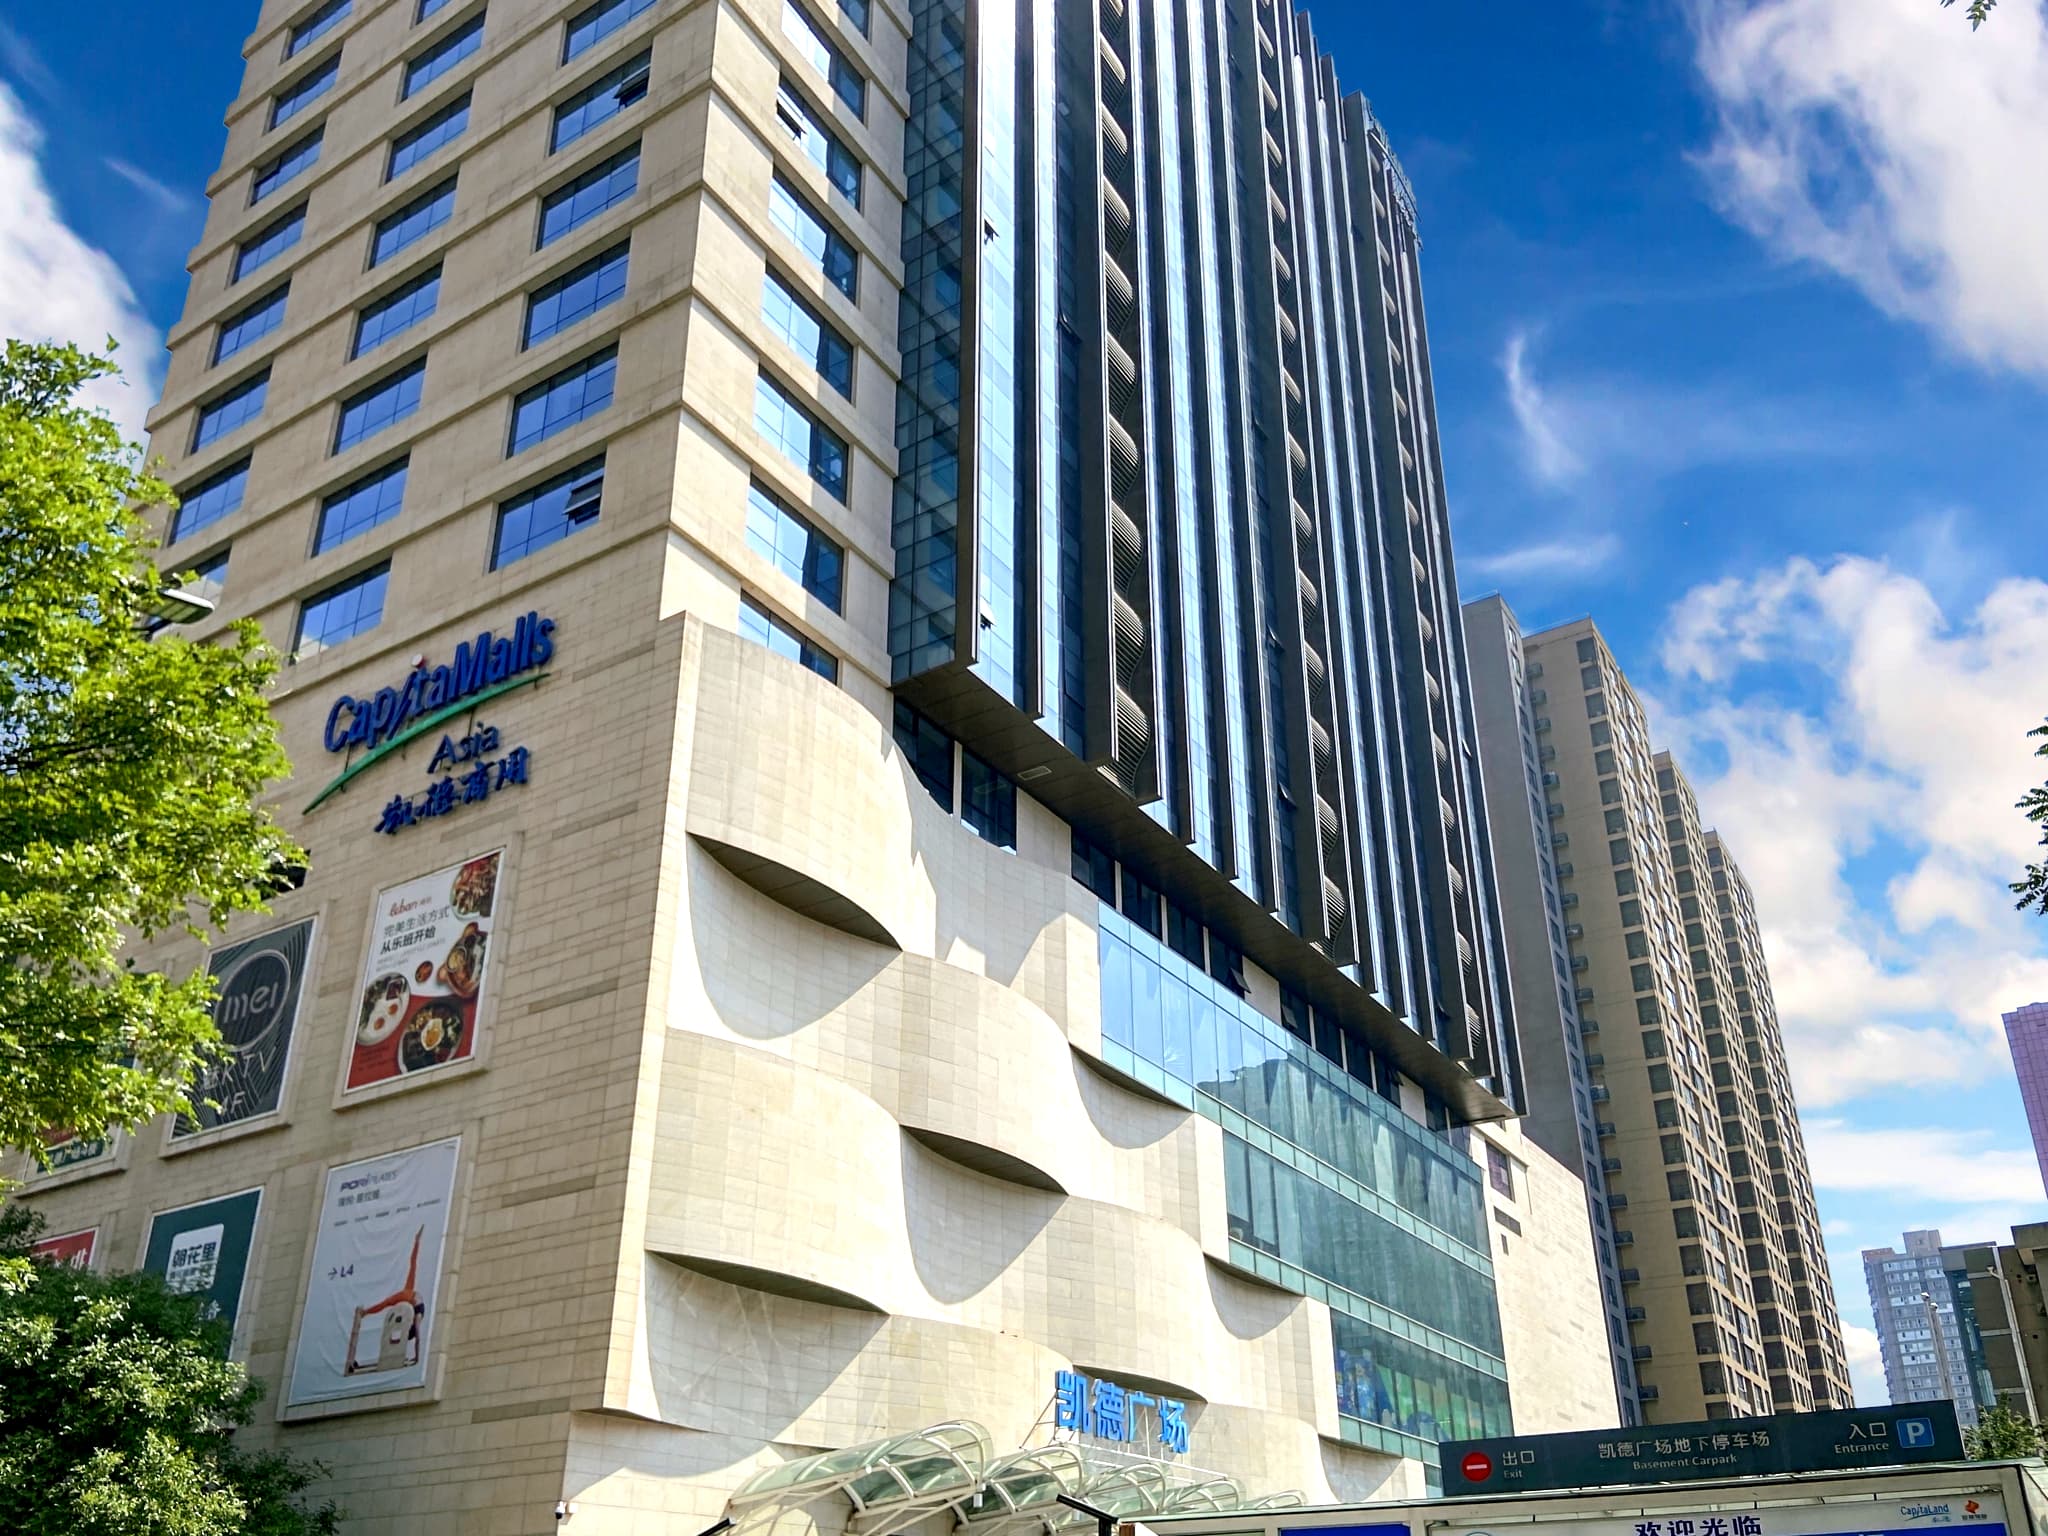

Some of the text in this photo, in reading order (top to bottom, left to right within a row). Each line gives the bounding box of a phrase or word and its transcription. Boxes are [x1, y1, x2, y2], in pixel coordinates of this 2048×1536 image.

[324, 610, 556, 753] CapitaMalls
[427, 722, 501, 774] Asia
[380, 925, 436, 955] 从乐班开始
[339, 1263, 354, 1278] L4
[1055, 1370, 1190, 1454] 凯德广场
[1849, 1422, 1887, 1440] 入口
[1598, 1431, 1770, 1459] 凯德广场地下停车场
[1834, 1441, 1889, 1454] Entrance
[1503, 1450, 1535, 1466] 出口
[1633, 1453, 1738, 1470] Basement Carpark
[1504, 1469, 1523, 1479] Exit
[1900, 1503, 1950, 1517] CapitaLand
[1634, 1516, 1763, 1536] 欢迎光临
